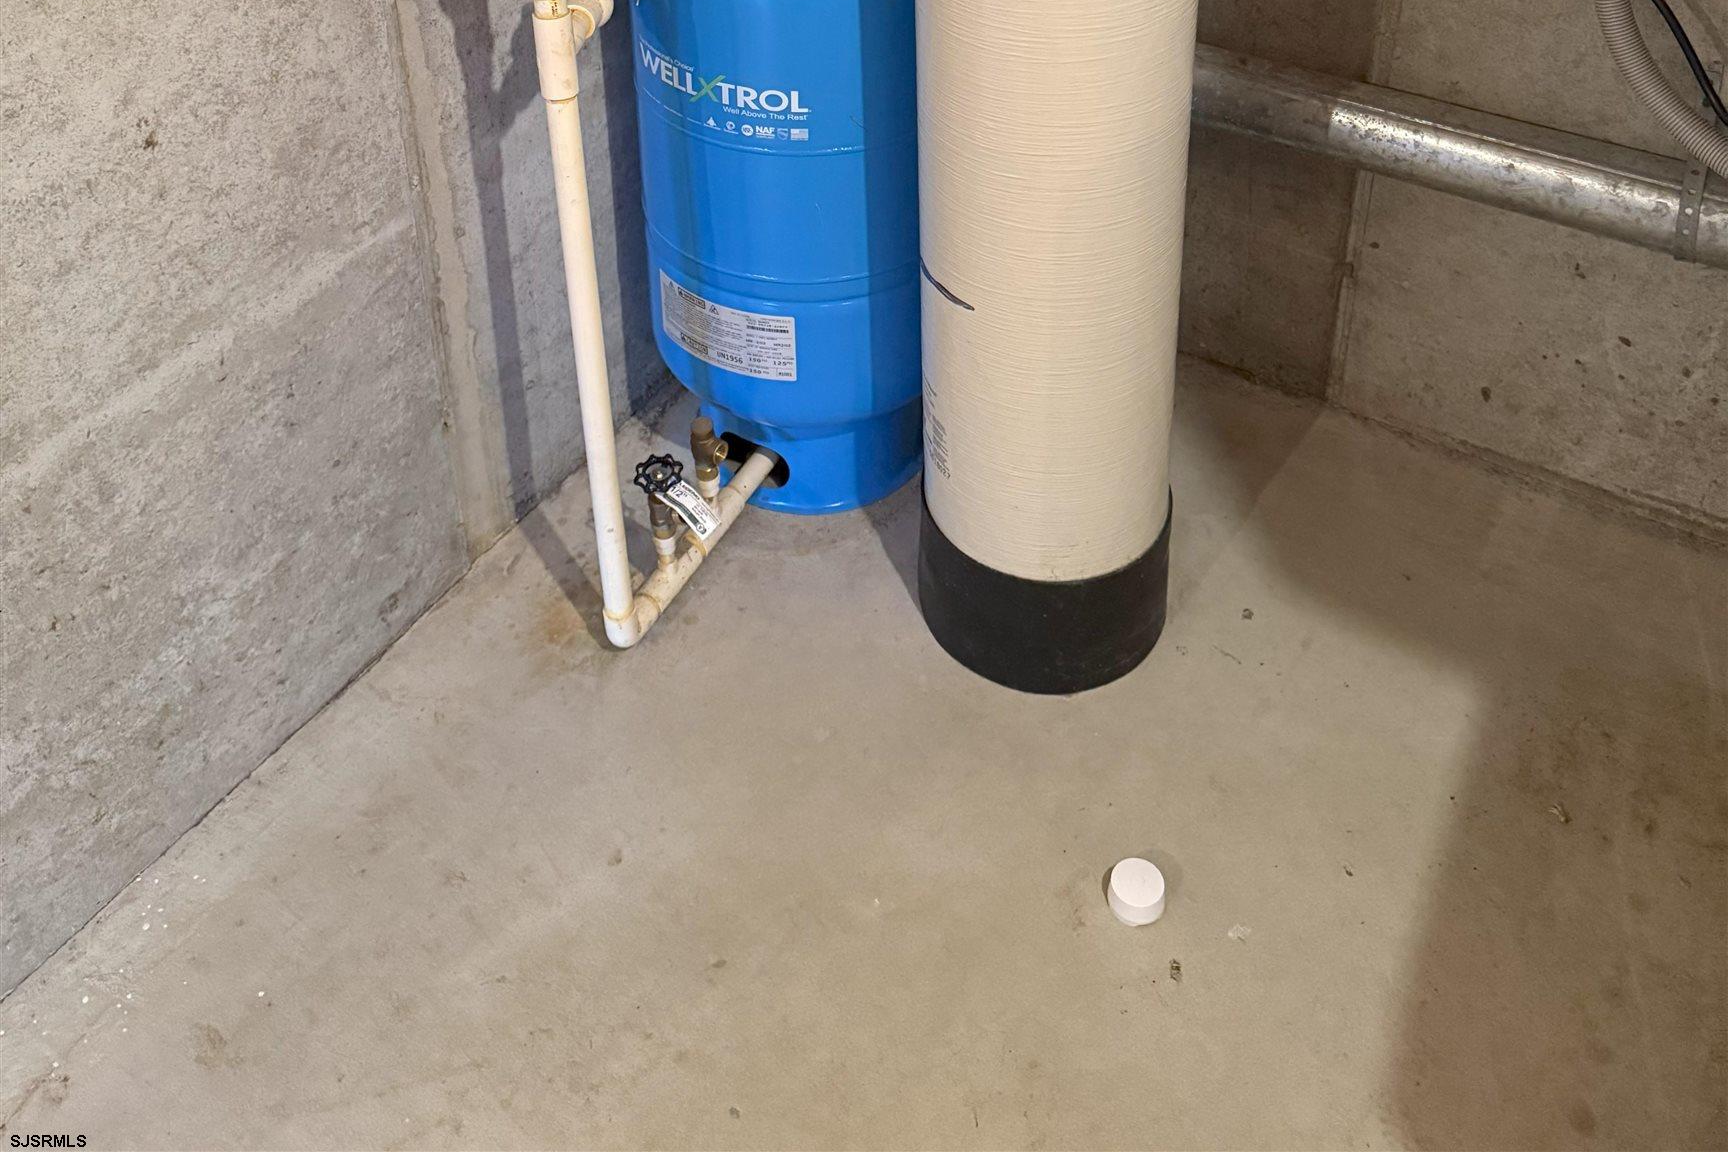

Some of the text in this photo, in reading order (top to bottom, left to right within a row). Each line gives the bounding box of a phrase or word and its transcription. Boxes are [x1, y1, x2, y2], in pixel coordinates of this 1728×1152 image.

[722, 106, 740, 115] Well
[740, 109, 767, 119] Above
[769, 112, 786, 121] The
